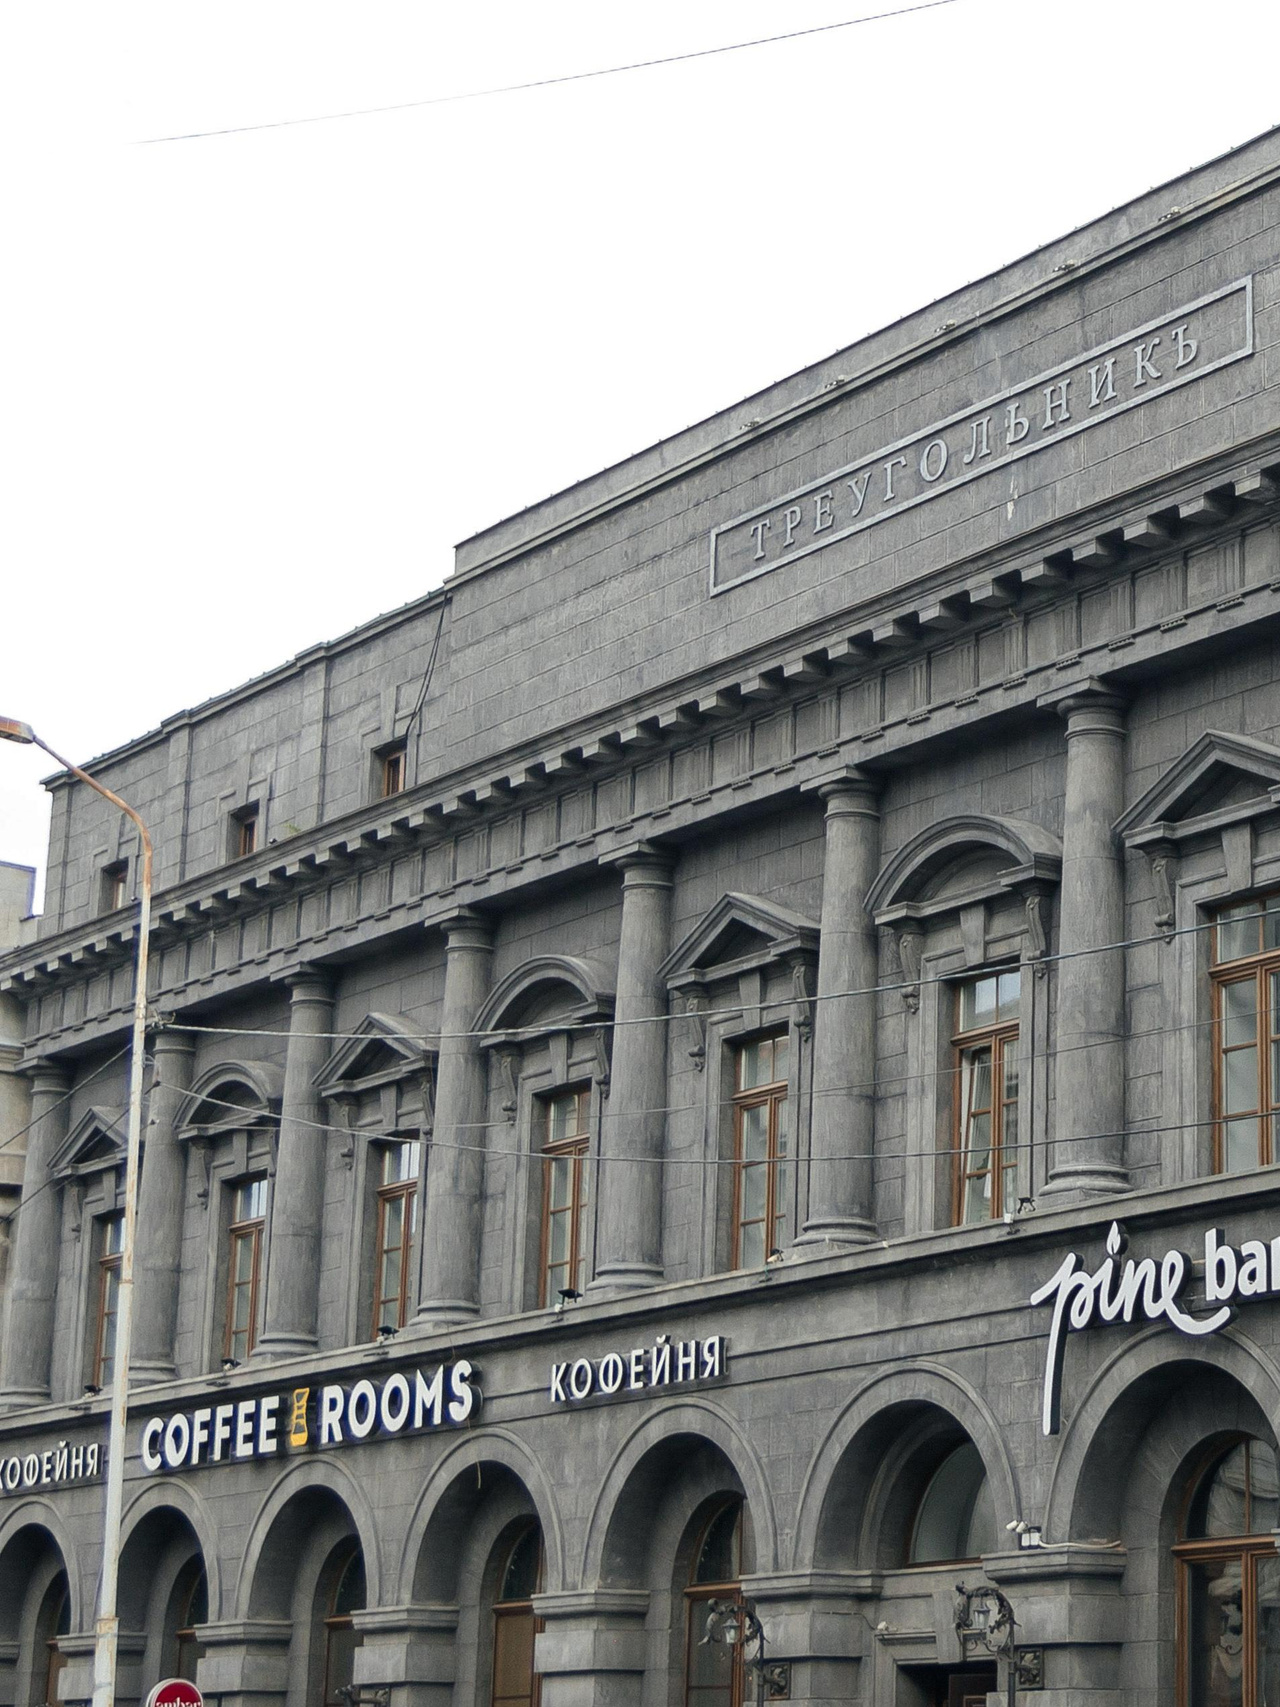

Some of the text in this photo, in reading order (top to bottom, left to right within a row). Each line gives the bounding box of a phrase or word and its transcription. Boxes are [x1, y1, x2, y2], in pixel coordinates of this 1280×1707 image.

[750, 323, 1199, 561] ТРЕУГОЛЬНИКЪ
[551, 1334, 720, 1402] КОФЕЙНЯ
[1030, 1220, 1231, 1436] pine
[142, 1359, 474, 1471] COFFEE ROOMS
